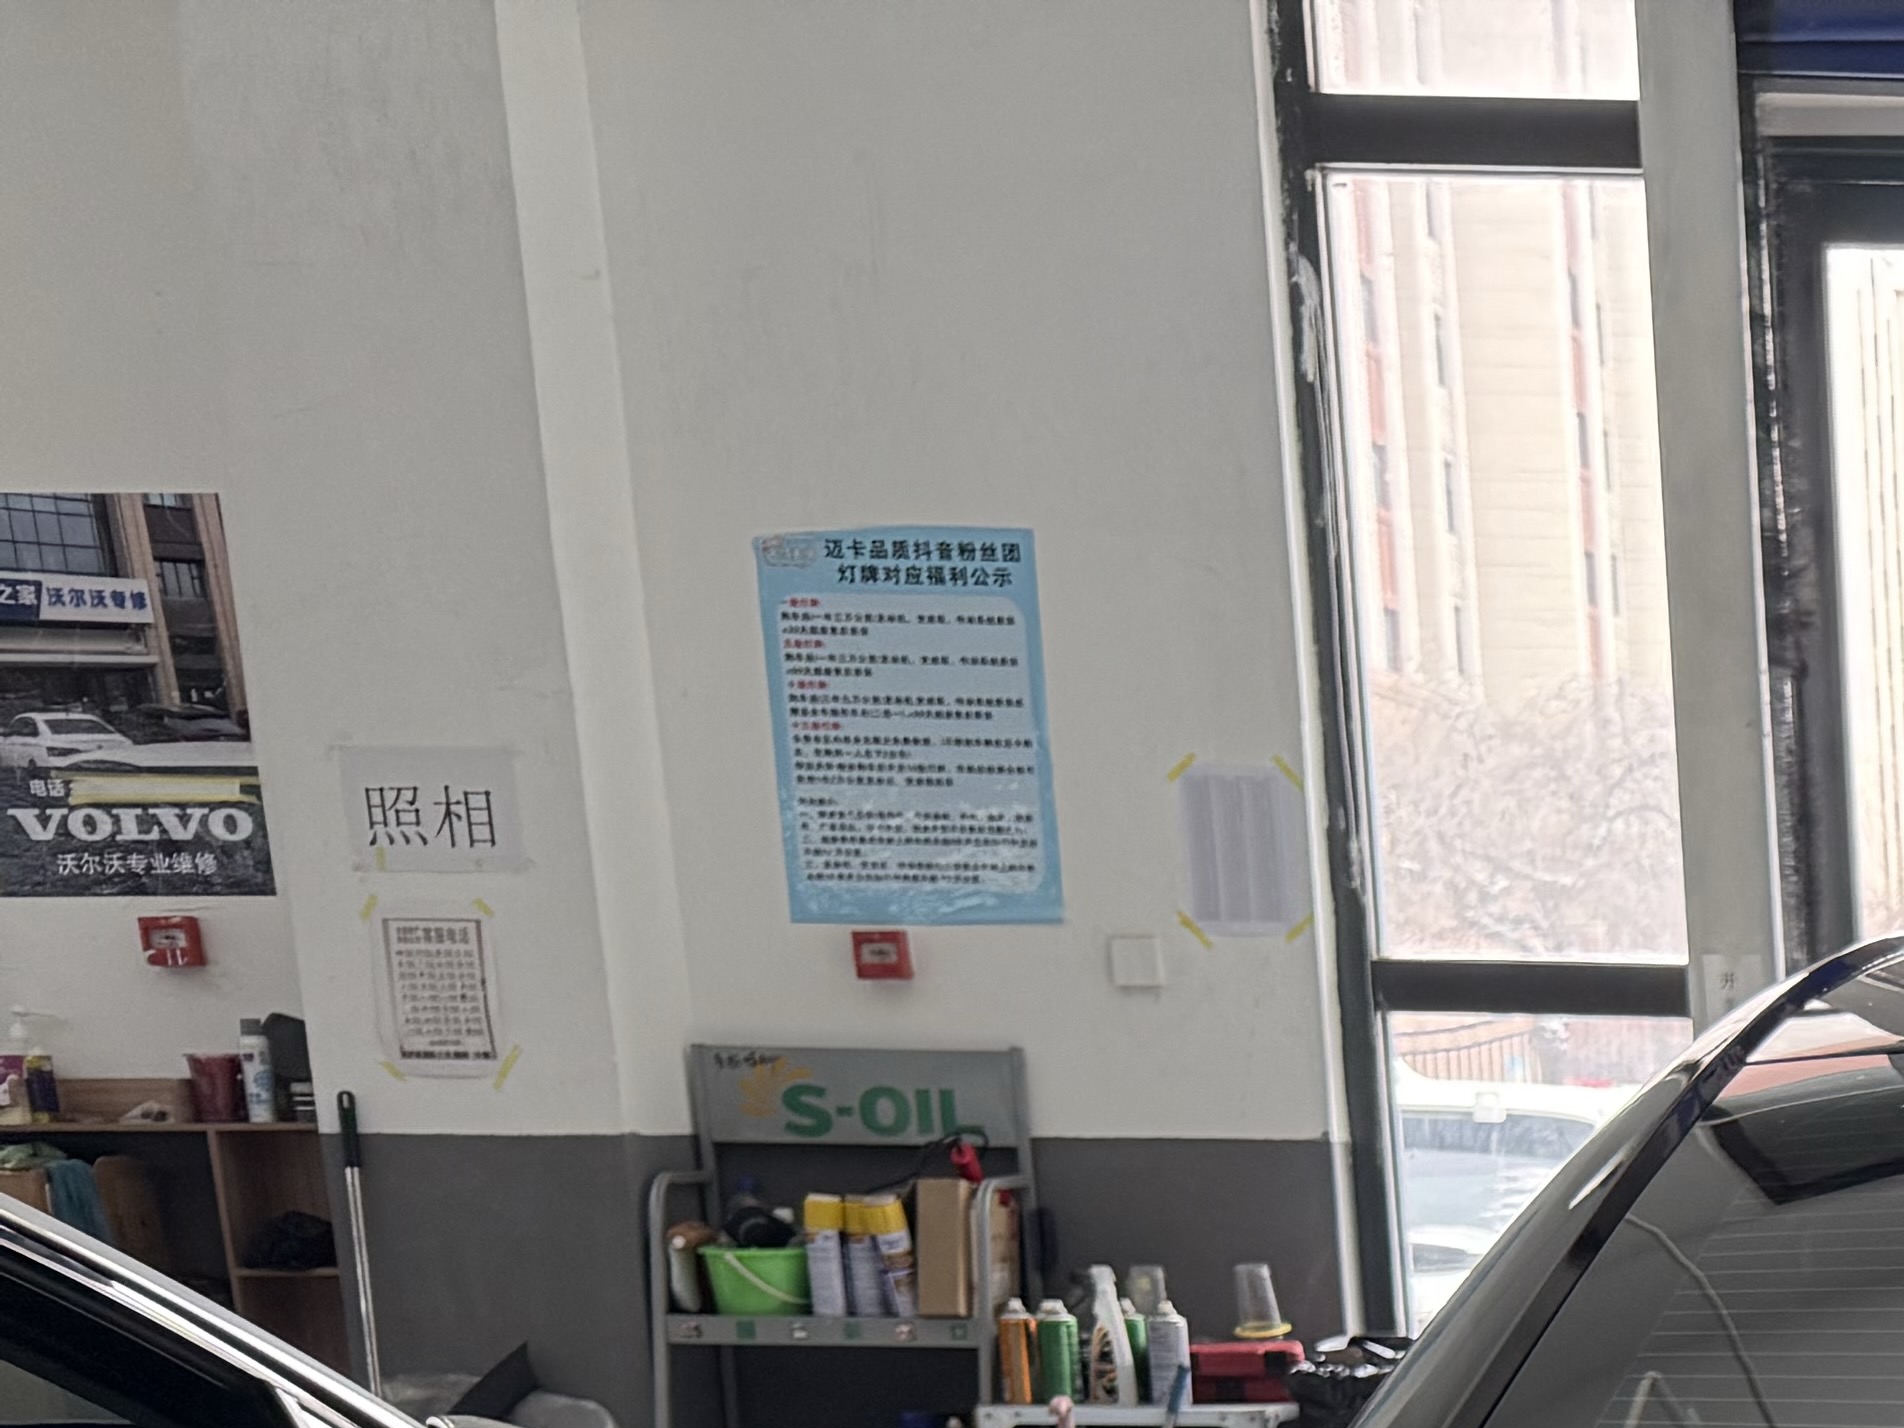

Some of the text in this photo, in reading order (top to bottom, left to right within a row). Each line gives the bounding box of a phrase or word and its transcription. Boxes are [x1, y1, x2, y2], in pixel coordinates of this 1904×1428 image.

[824, 538, 1022, 563] 迈卡品质抖音粉丝团
[837, 564, 1013, 588] 灯牌对应福利公示
[6, 807, 254, 842] VOLVO
[364, 784, 497, 849] 照相
[56, 851, 219, 877] 沃尔沃专业维修
[781, 1083, 986, 1138] S-OIL
